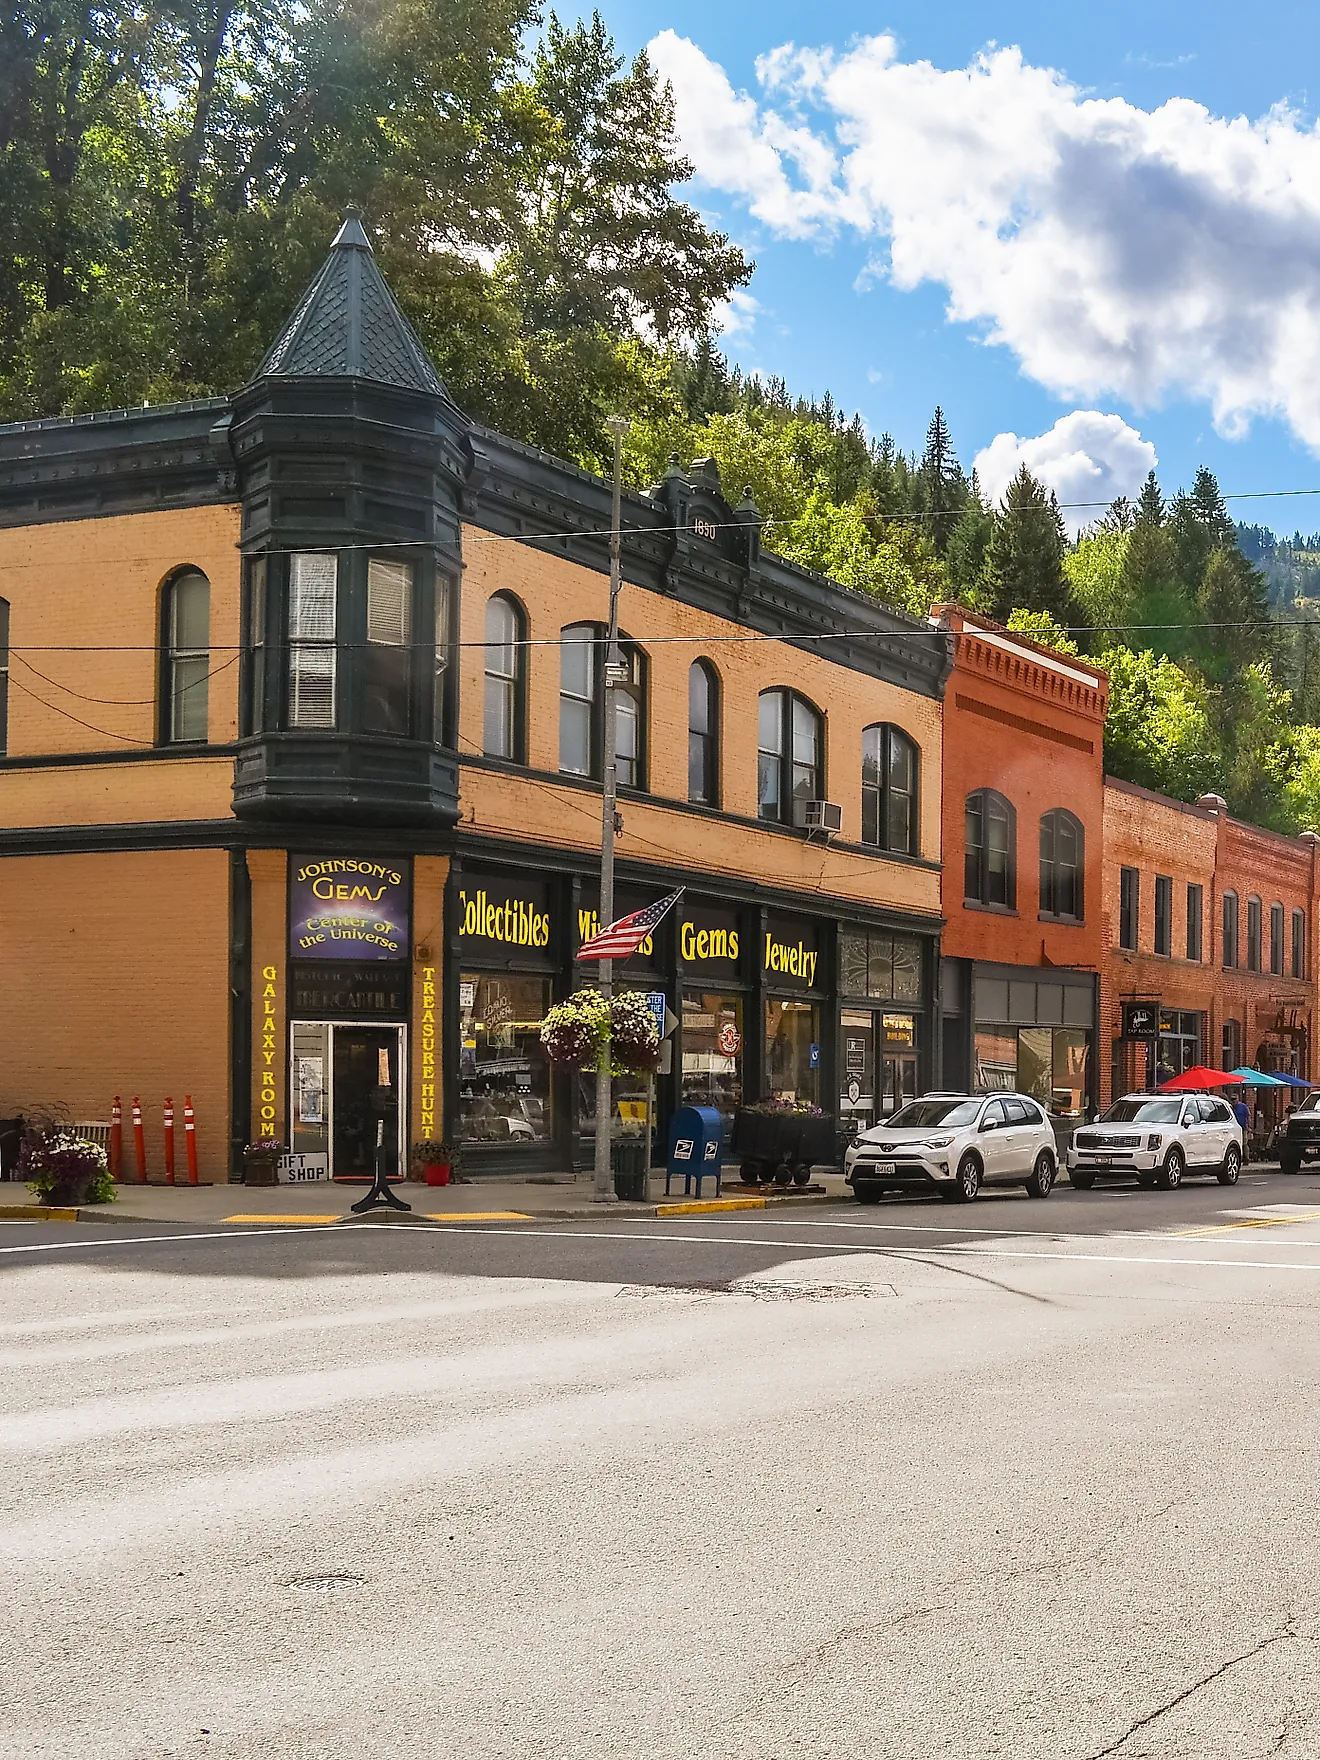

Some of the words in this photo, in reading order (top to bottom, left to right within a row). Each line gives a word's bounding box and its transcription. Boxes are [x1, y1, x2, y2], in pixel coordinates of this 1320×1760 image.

[297, 859, 402, 885] JOHNSON'S
[299, 932, 326, 949] the
[330, 928, 399, 952] Universe
[306, 915, 369, 931] Center
[373, 920, 394, 934] of
[681, 921, 739, 961] Gems
[765, 932, 818, 987] Jewelry
[262, 966, 277, 1065] GALAXY
[422, 967, 435, 1079] TREASURE
[260, 1071, 276, 1136] ROOM
[422, 1083, 435, 1139] HUNT
[276, 1154, 306, 1169] GIFT
[288, 1166, 325, 1182] SHOP
